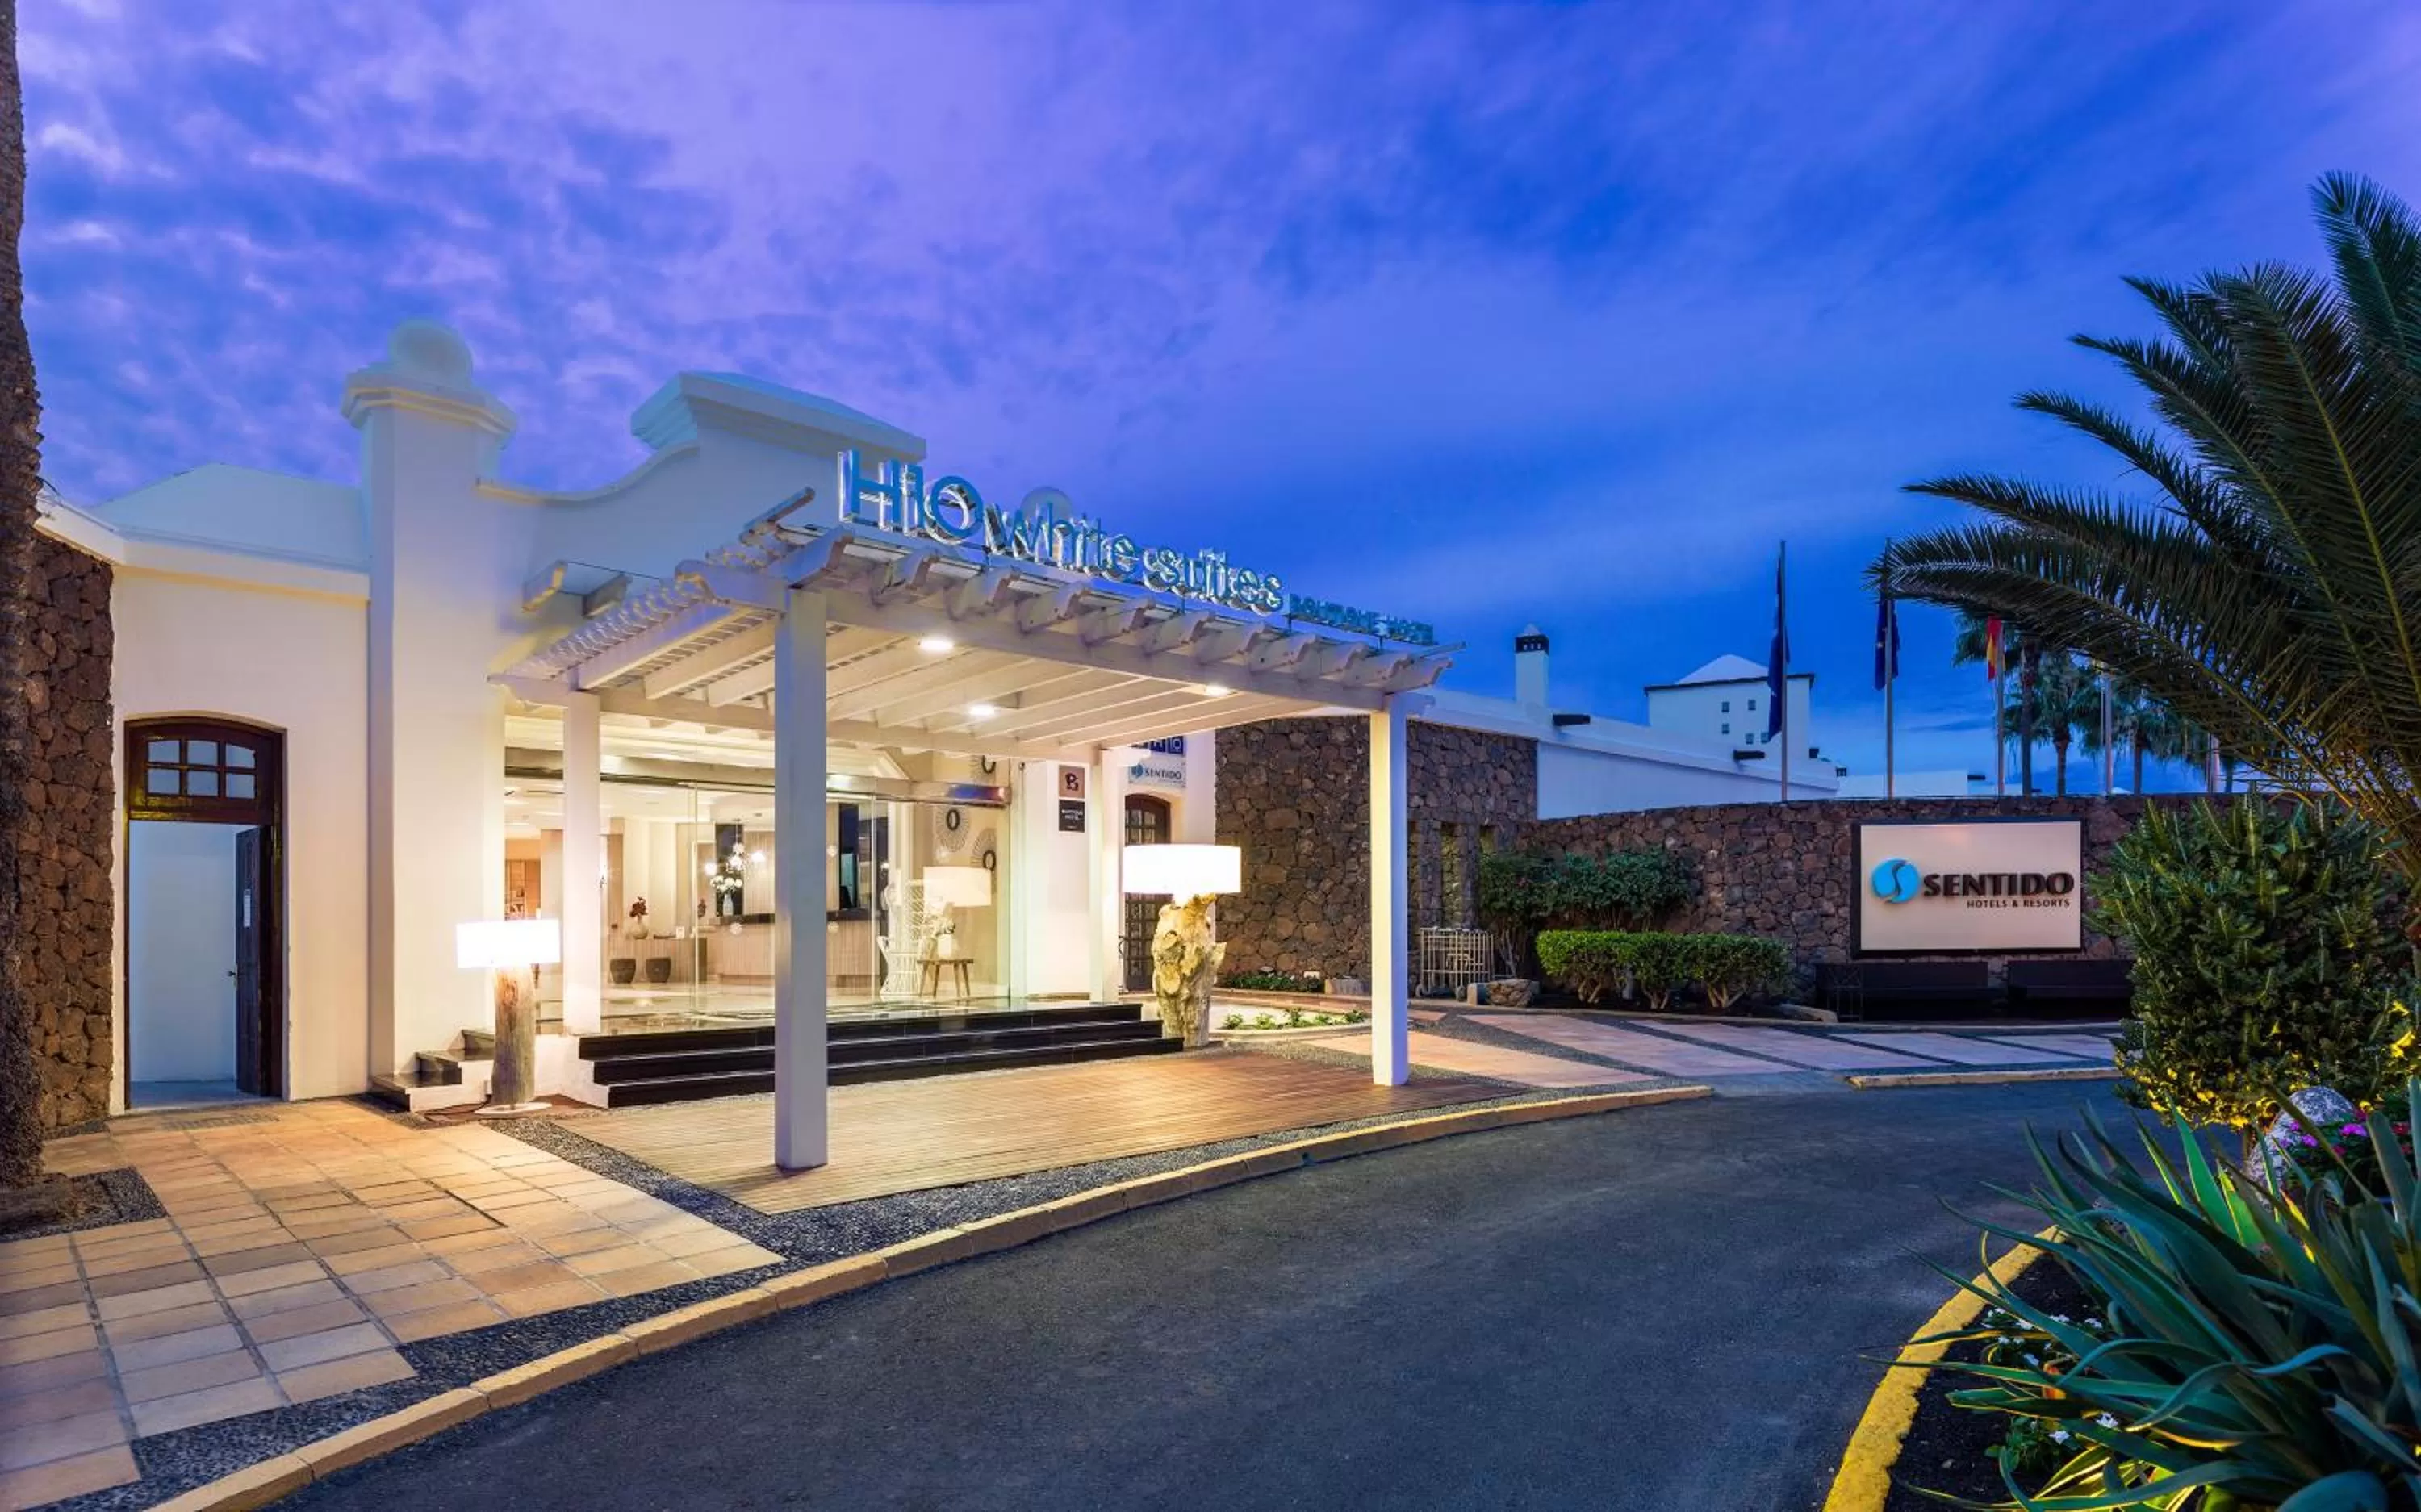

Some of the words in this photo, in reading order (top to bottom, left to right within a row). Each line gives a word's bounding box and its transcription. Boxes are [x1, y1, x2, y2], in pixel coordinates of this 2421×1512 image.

[984, 499, 1141, 583] white
[1143, 543, 1285, 617] suites
[1922, 871, 2075, 897] SENTIDO
[1967, 900, 2007, 908] HOTELS
[2012, 900, 2018, 908] &
[2023, 899, 2071, 908] RESORTS
